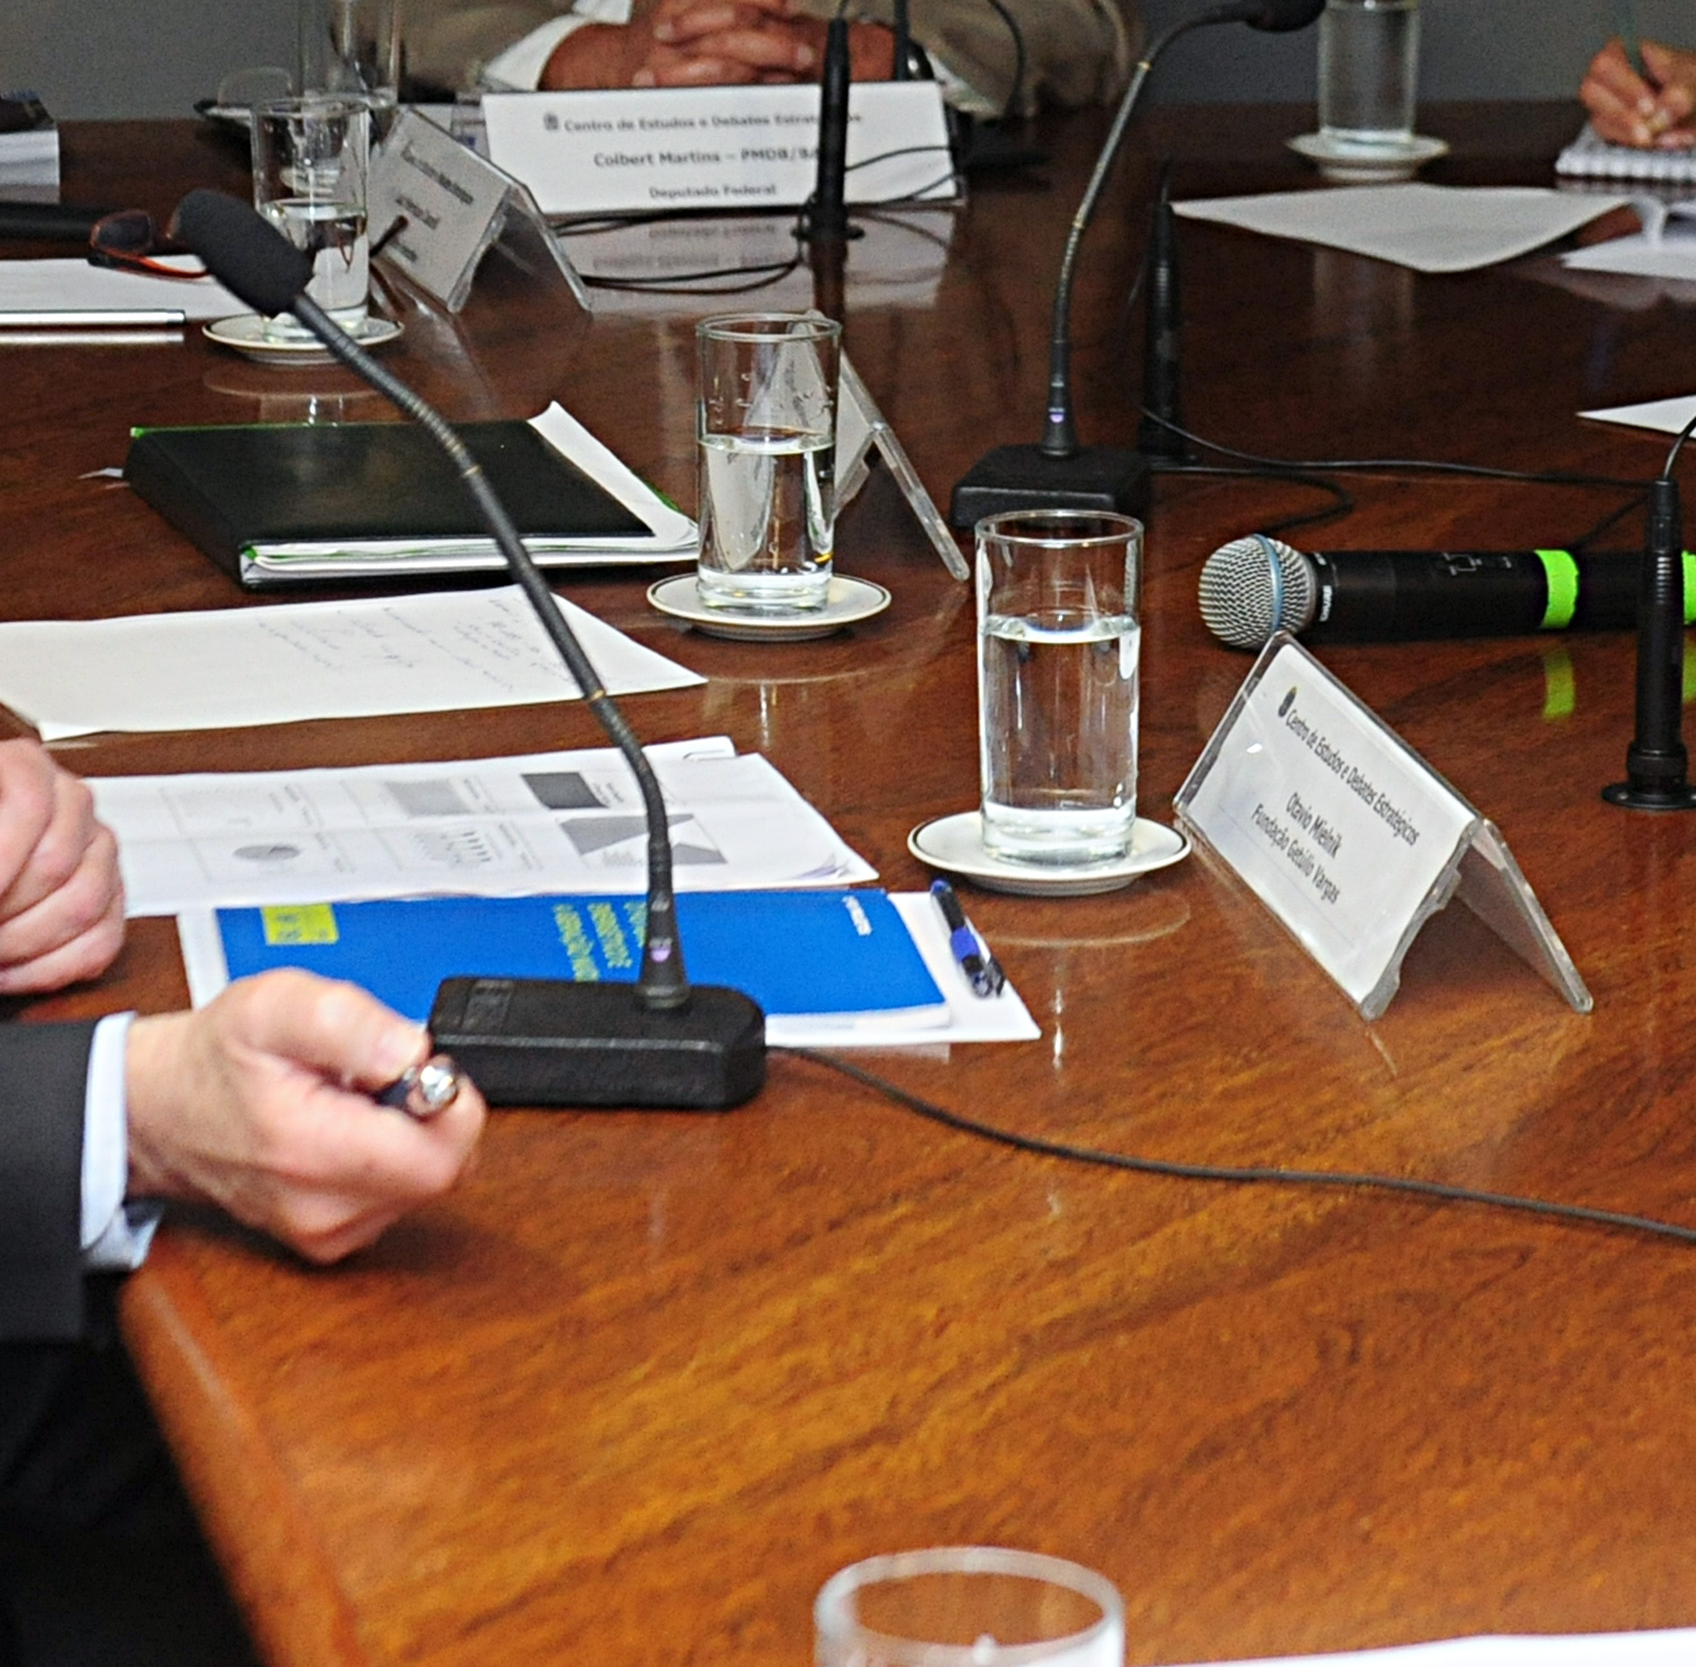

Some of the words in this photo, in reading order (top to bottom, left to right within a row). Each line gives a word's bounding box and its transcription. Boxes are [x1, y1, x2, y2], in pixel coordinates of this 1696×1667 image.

[564, 118, 613, 132] Centro
[617, 118, 635, 130] de
[638, 116, 695, 130] Estudos
[711, 114, 771, 126] Debates
[774, 113, 862, 126] Estratos
[593, 151, 654, 167] Colbert
[658, 149, 721, 166] Martins
[649, 185, 719, 200] Deputado
[723, 184, 777, 196] Federal
[1285, 708, 1311, 742] Centro
[1306, 729, 1318, 750] de
[1314, 735, 1346, 775] Estudos
[1339, 766, 1349, 780] e
[1345, 766, 1378, 807] Debates
[1372, 792, 1421, 847] Estratégicos
[1285, 791, 1313, 831] Otavio
[1308, 814, 1343, 859] Mielnik
[1251, 803, 1291, 852] Fundação
[1286, 838, 1316, 878] Getúlio
[1312, 865, 1341, 904] Vargas
